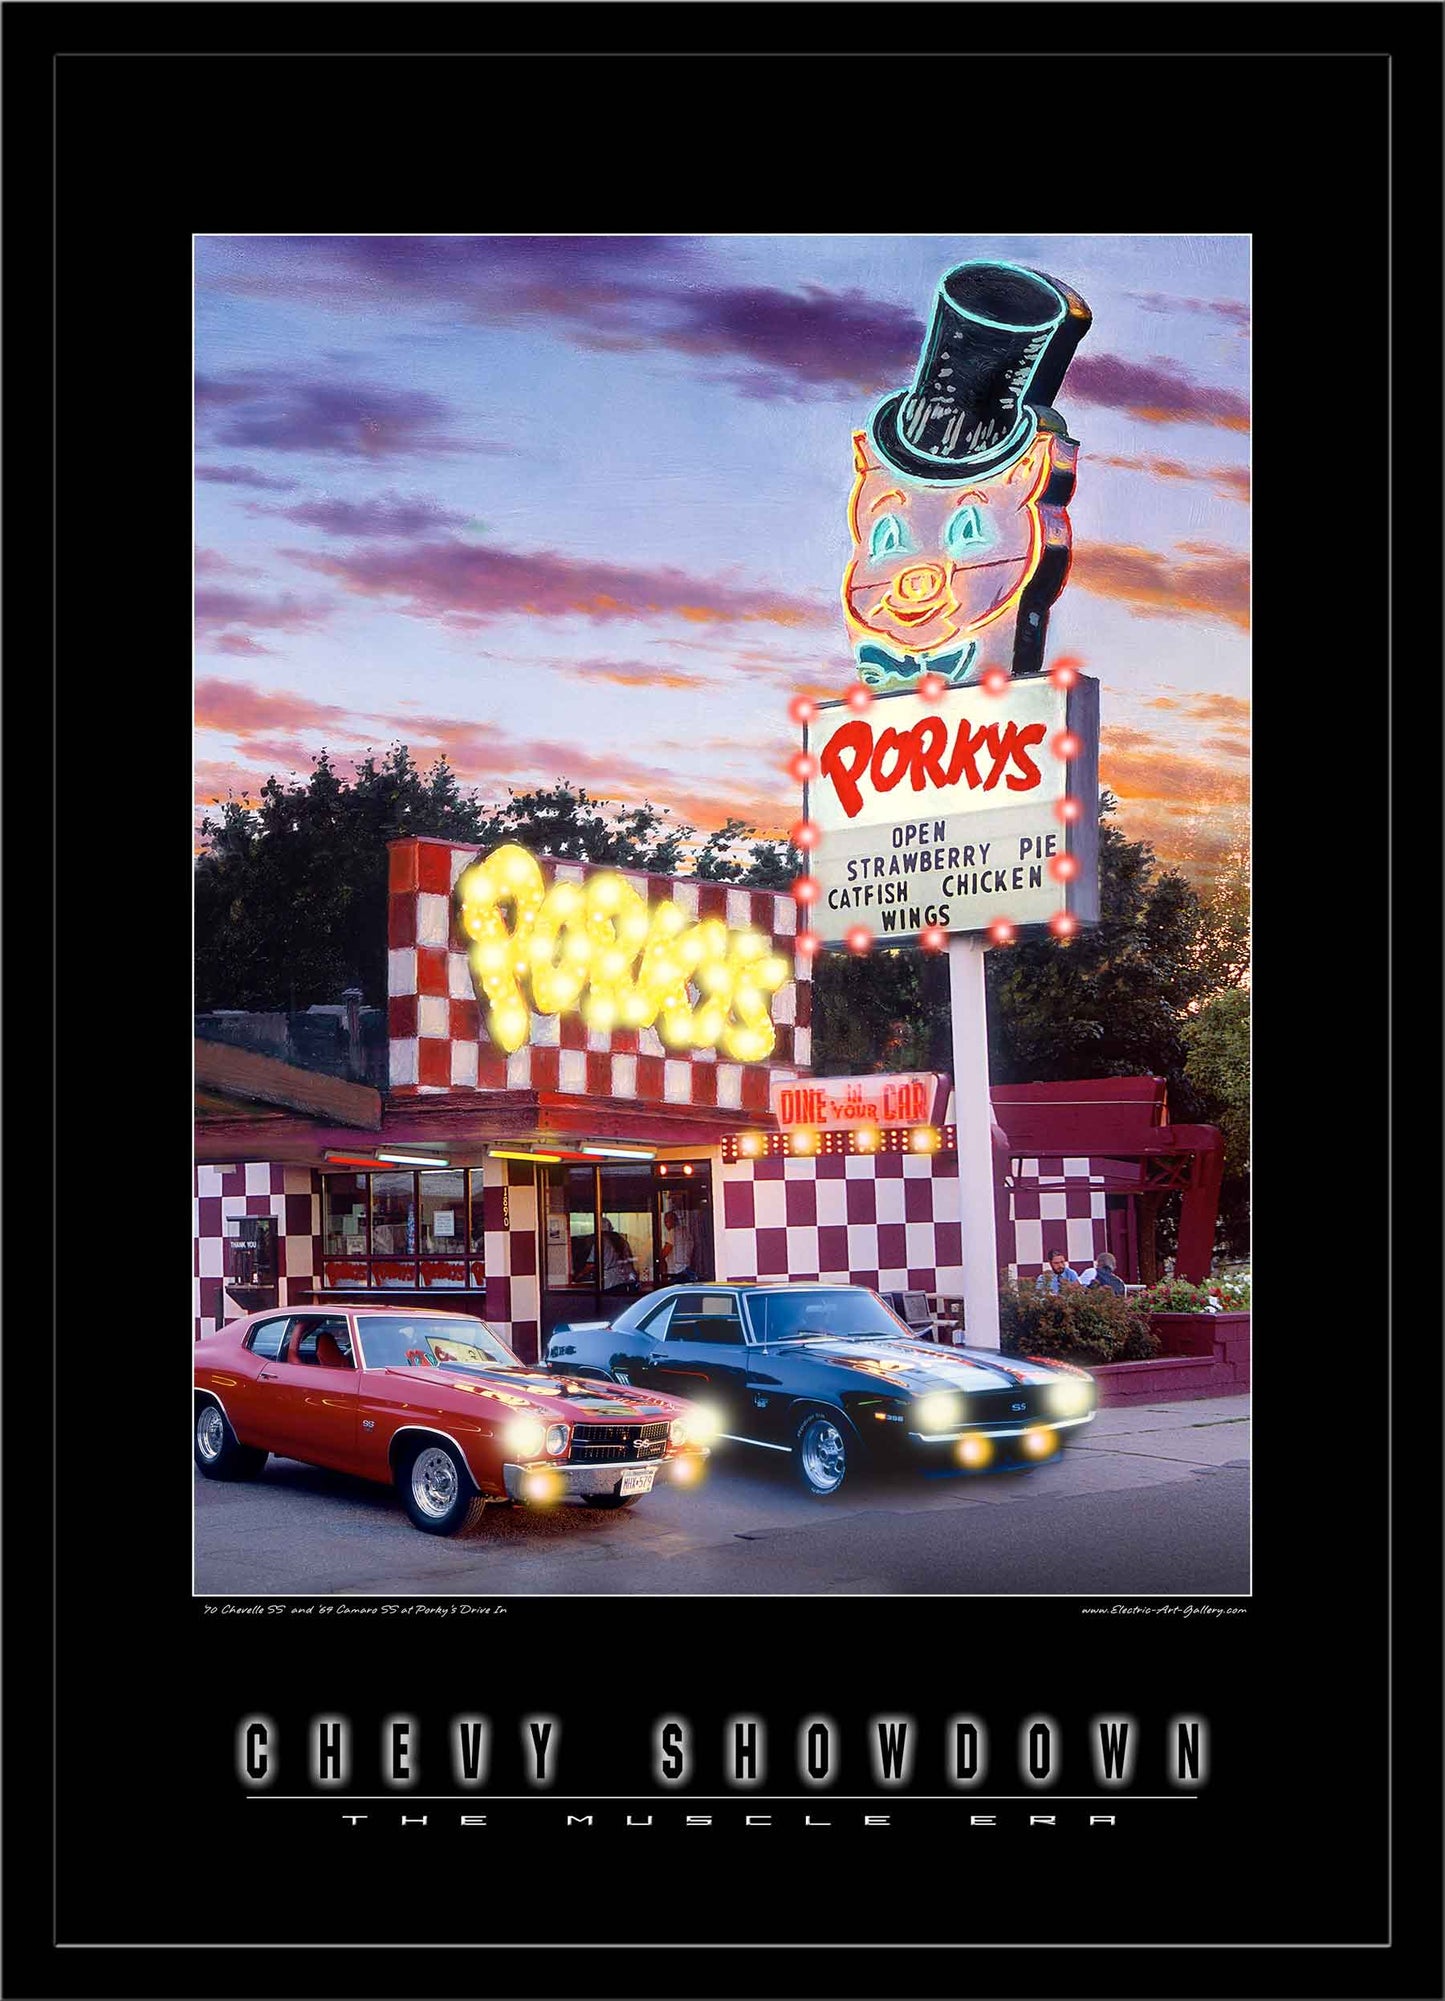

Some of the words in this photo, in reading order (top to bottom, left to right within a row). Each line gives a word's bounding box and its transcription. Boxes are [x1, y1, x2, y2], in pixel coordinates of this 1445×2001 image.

[820, 716, 1047, 818] PORKYS
[892, 820, 946, 848] OPEN
[847, 843, 991, 882] STRAWBERRY
[1019, 834, 1057, 861] PIE
[828, 881, 908, 910] CATFISH
[942, 866, 1042, 898] CHICKEN
[882, 905, 951, 932] WINGS
[781, 1089, 827, 1125] DINE
[831, 1101, 879, 1122] YOUR
[883, 1082, 928, 1121] CAR
[230, 1241, 246, 1249] THANK
[247, 1241, 257, 1249] YOU
[1011, 1403, 1026, 1412] SS
